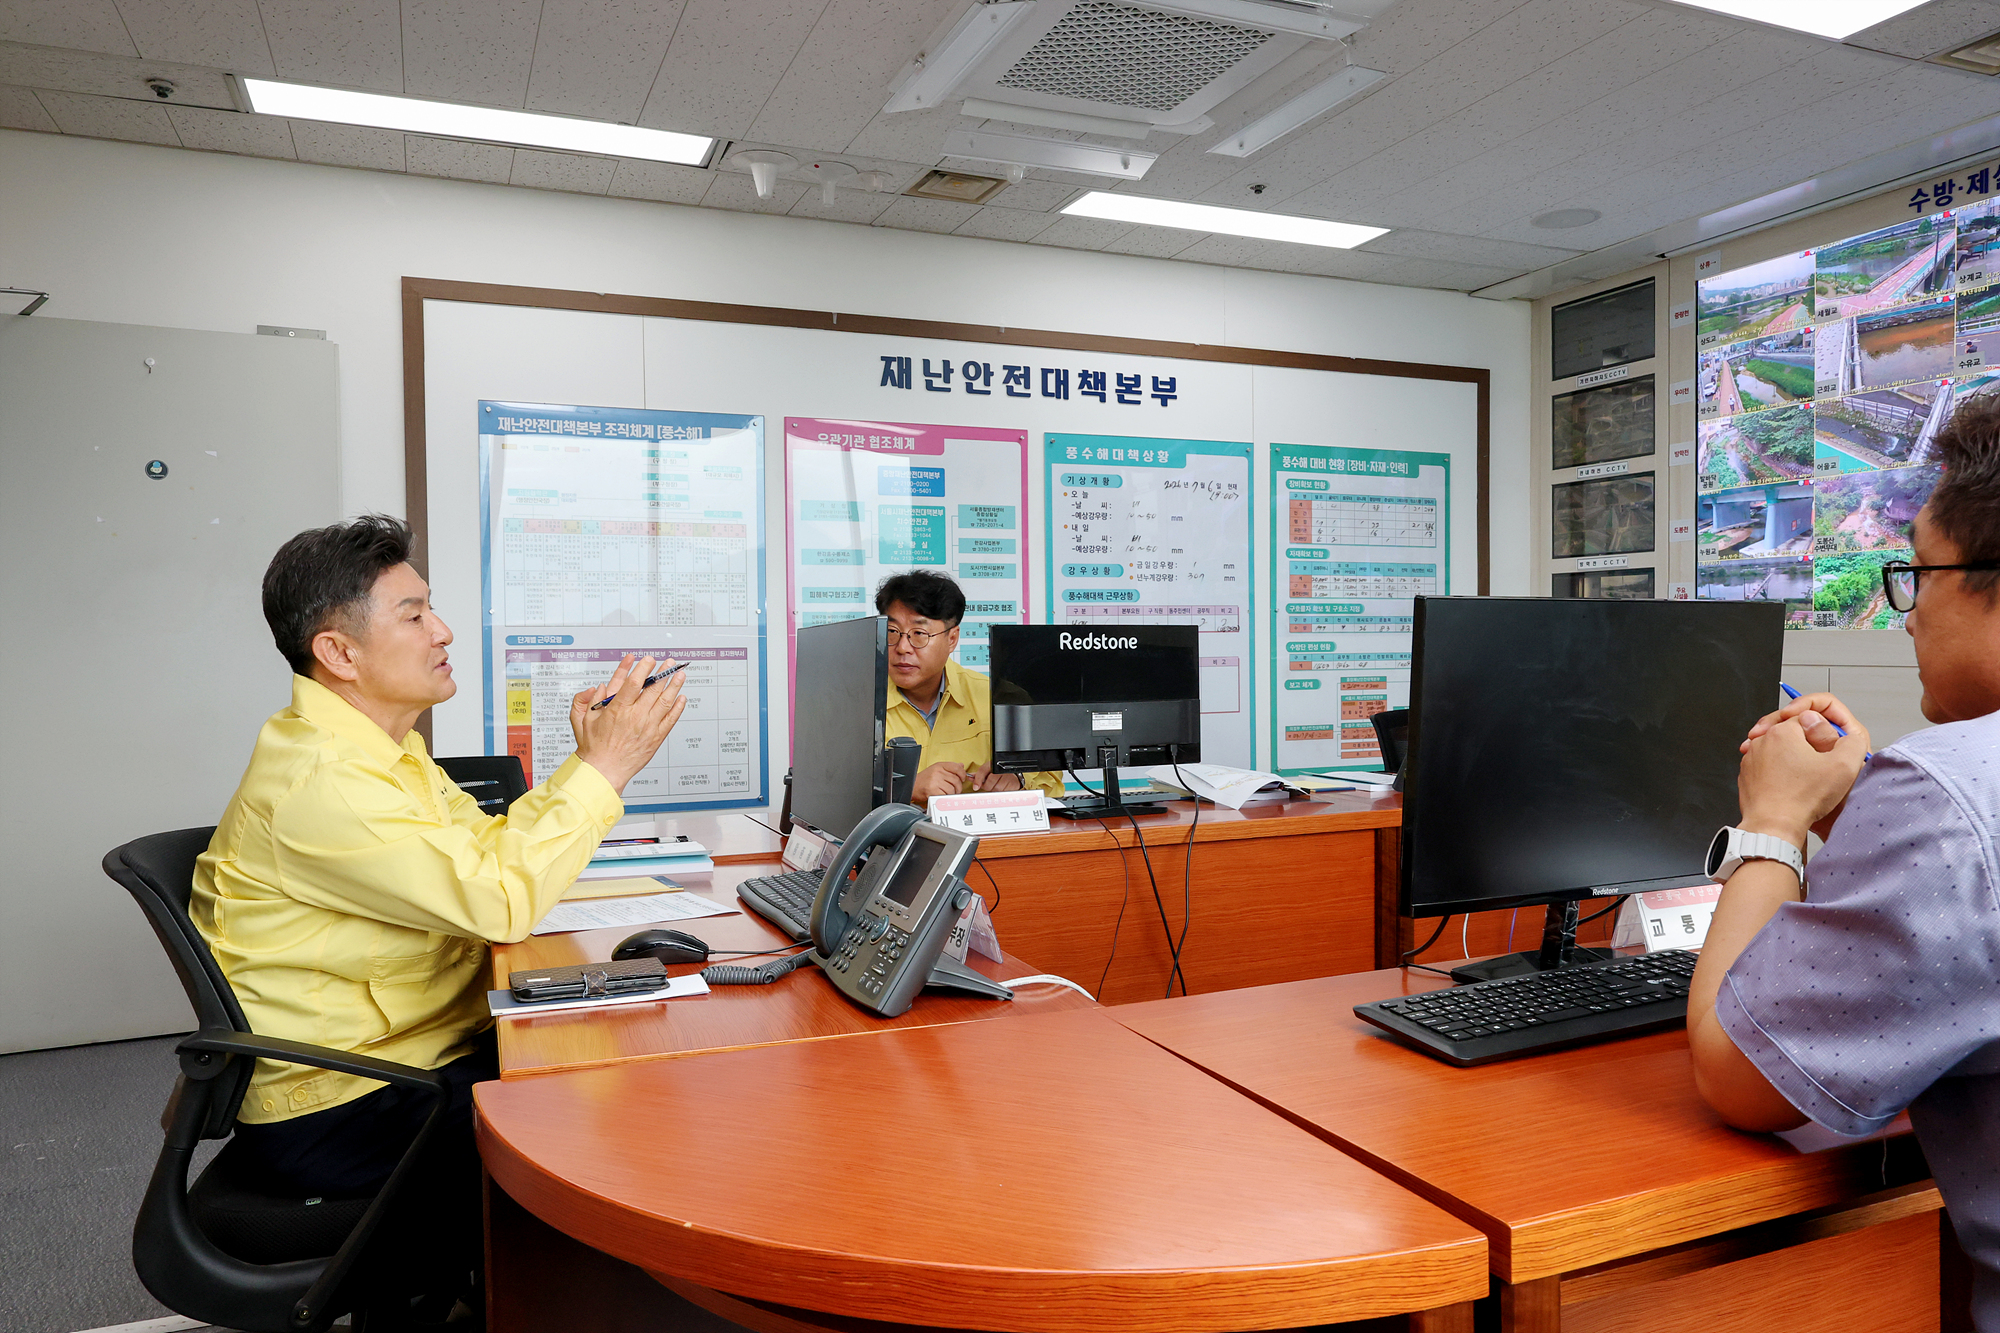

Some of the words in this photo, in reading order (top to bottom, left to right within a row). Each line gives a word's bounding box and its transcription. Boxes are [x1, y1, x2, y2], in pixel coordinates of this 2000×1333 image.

[1818, 307, 1838, 318] 세월교
[1959, 358, 1981, 369] 수유교
[881, 356, 1178, 407] 재난안전대책본부
[1817, 384, 1837, 394] 근화교
[498, 417, 602, 434] 재난안전대책본부
[605, 423, 654, 438] 조직체계
[657, 427, 703, 442] [풍수해]
[818, 433, 865, 449] 유관기관
[869, 435, 915, 451] 협조체계
[1066, 447, 1170, 464] 풍수해대책상황
[1283, 456, 1308, 469] 풍수해
[1310, 458, 1327, 470] 대비
[1329, 459, 1345, 471] 현황
[1607, 465, 1626, 473] CCTV
[1067, 476, 1110, 486] 기상개황
[1289, 480, 1313, 489] 장비확보
[1314, 481, 1326, 490] 현황
[1072, 491, 1089, 499] 오늘
[1072, 524, 1089, 532] 내일
[1068, 566, 1111, 576] 강우상황
[810, 591, 860, 599] 피해복구협조기관
[1069, 591, 1104, 601] 풍수해대책
[1106, 591, 1134, 601] 근무상황
[518, 636, 537, 644] 단계별
[538, 636, 563, 644] 근무요령
[1060, 632, 1138, 650] Redstone
[1290, 681, 1301, 689] 보고
[1593, 887, 1619, 896] Redstone
